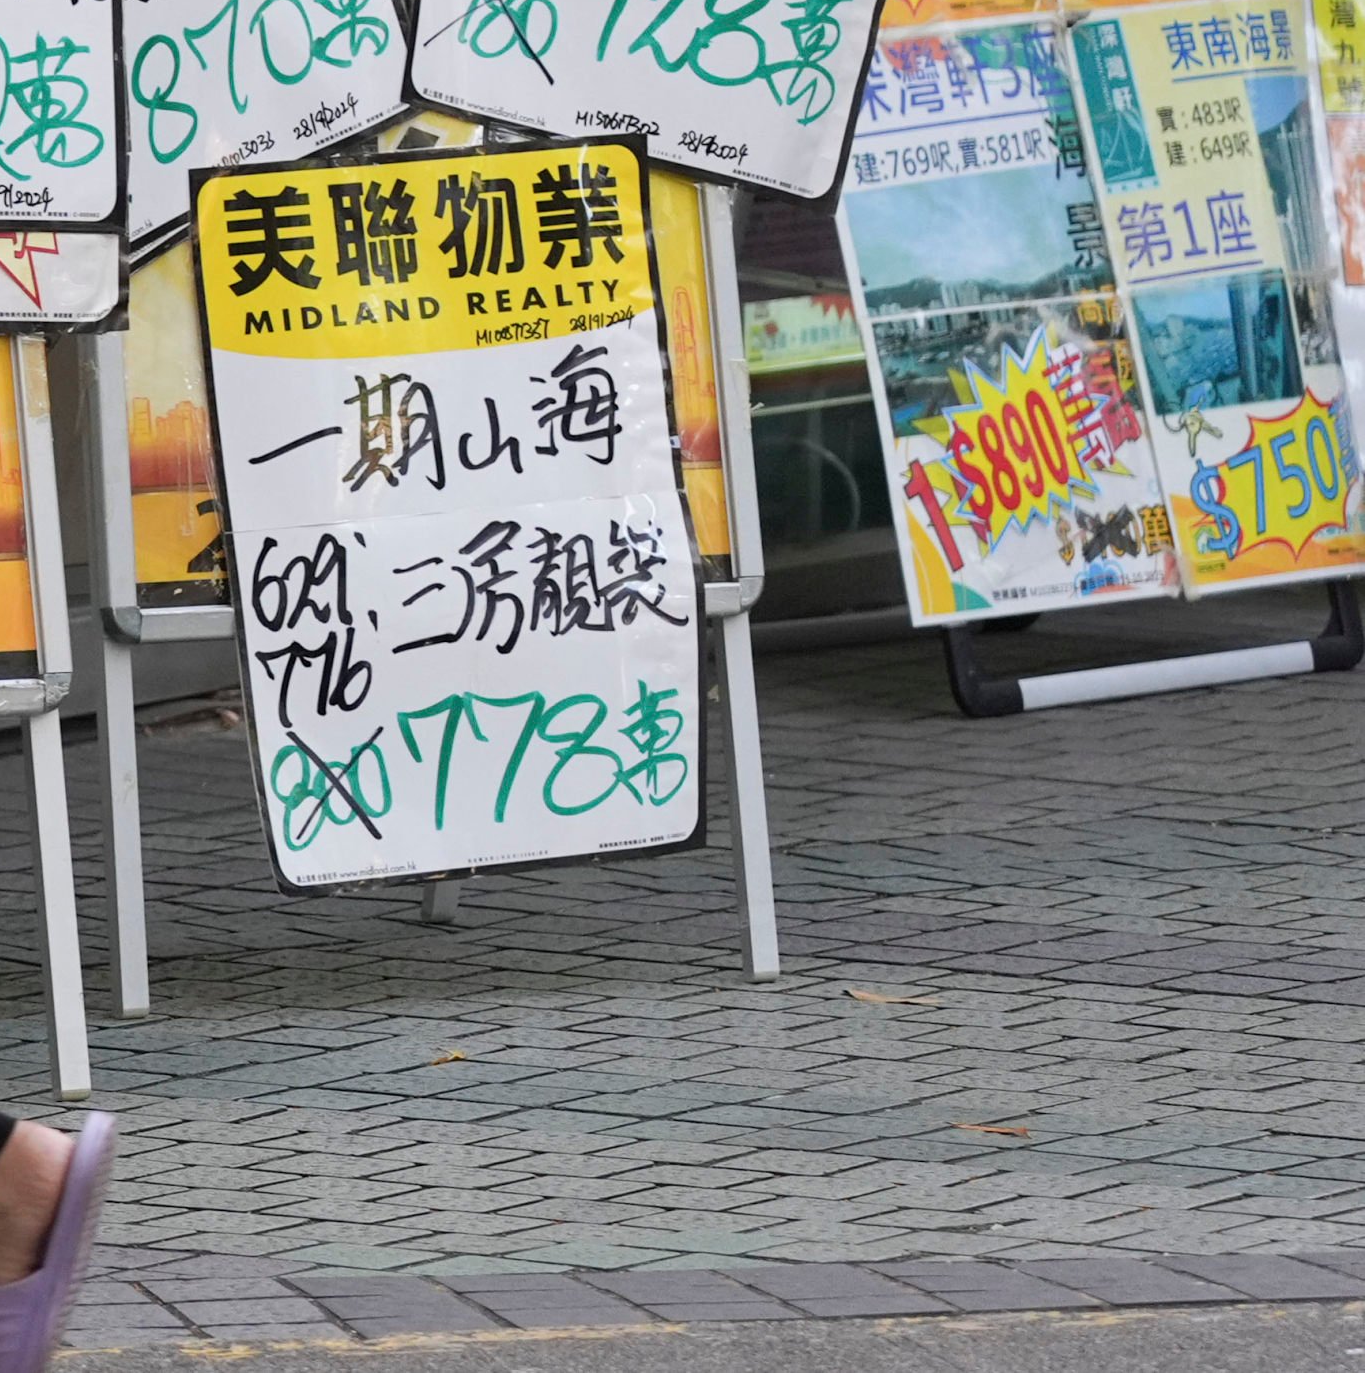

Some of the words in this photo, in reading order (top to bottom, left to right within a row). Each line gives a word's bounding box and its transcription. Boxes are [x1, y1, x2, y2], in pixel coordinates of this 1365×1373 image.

[1160, 10, 1295, 72] 東南海景
[222, 164, 626, 298] 美聯物業
[1115, 188, 1262, 271] 第1座
[244, 303, 440, 335] MIDLAND
[467, 277, 622, 317] REALTY
[397, 678, 690, 832] 778萬
